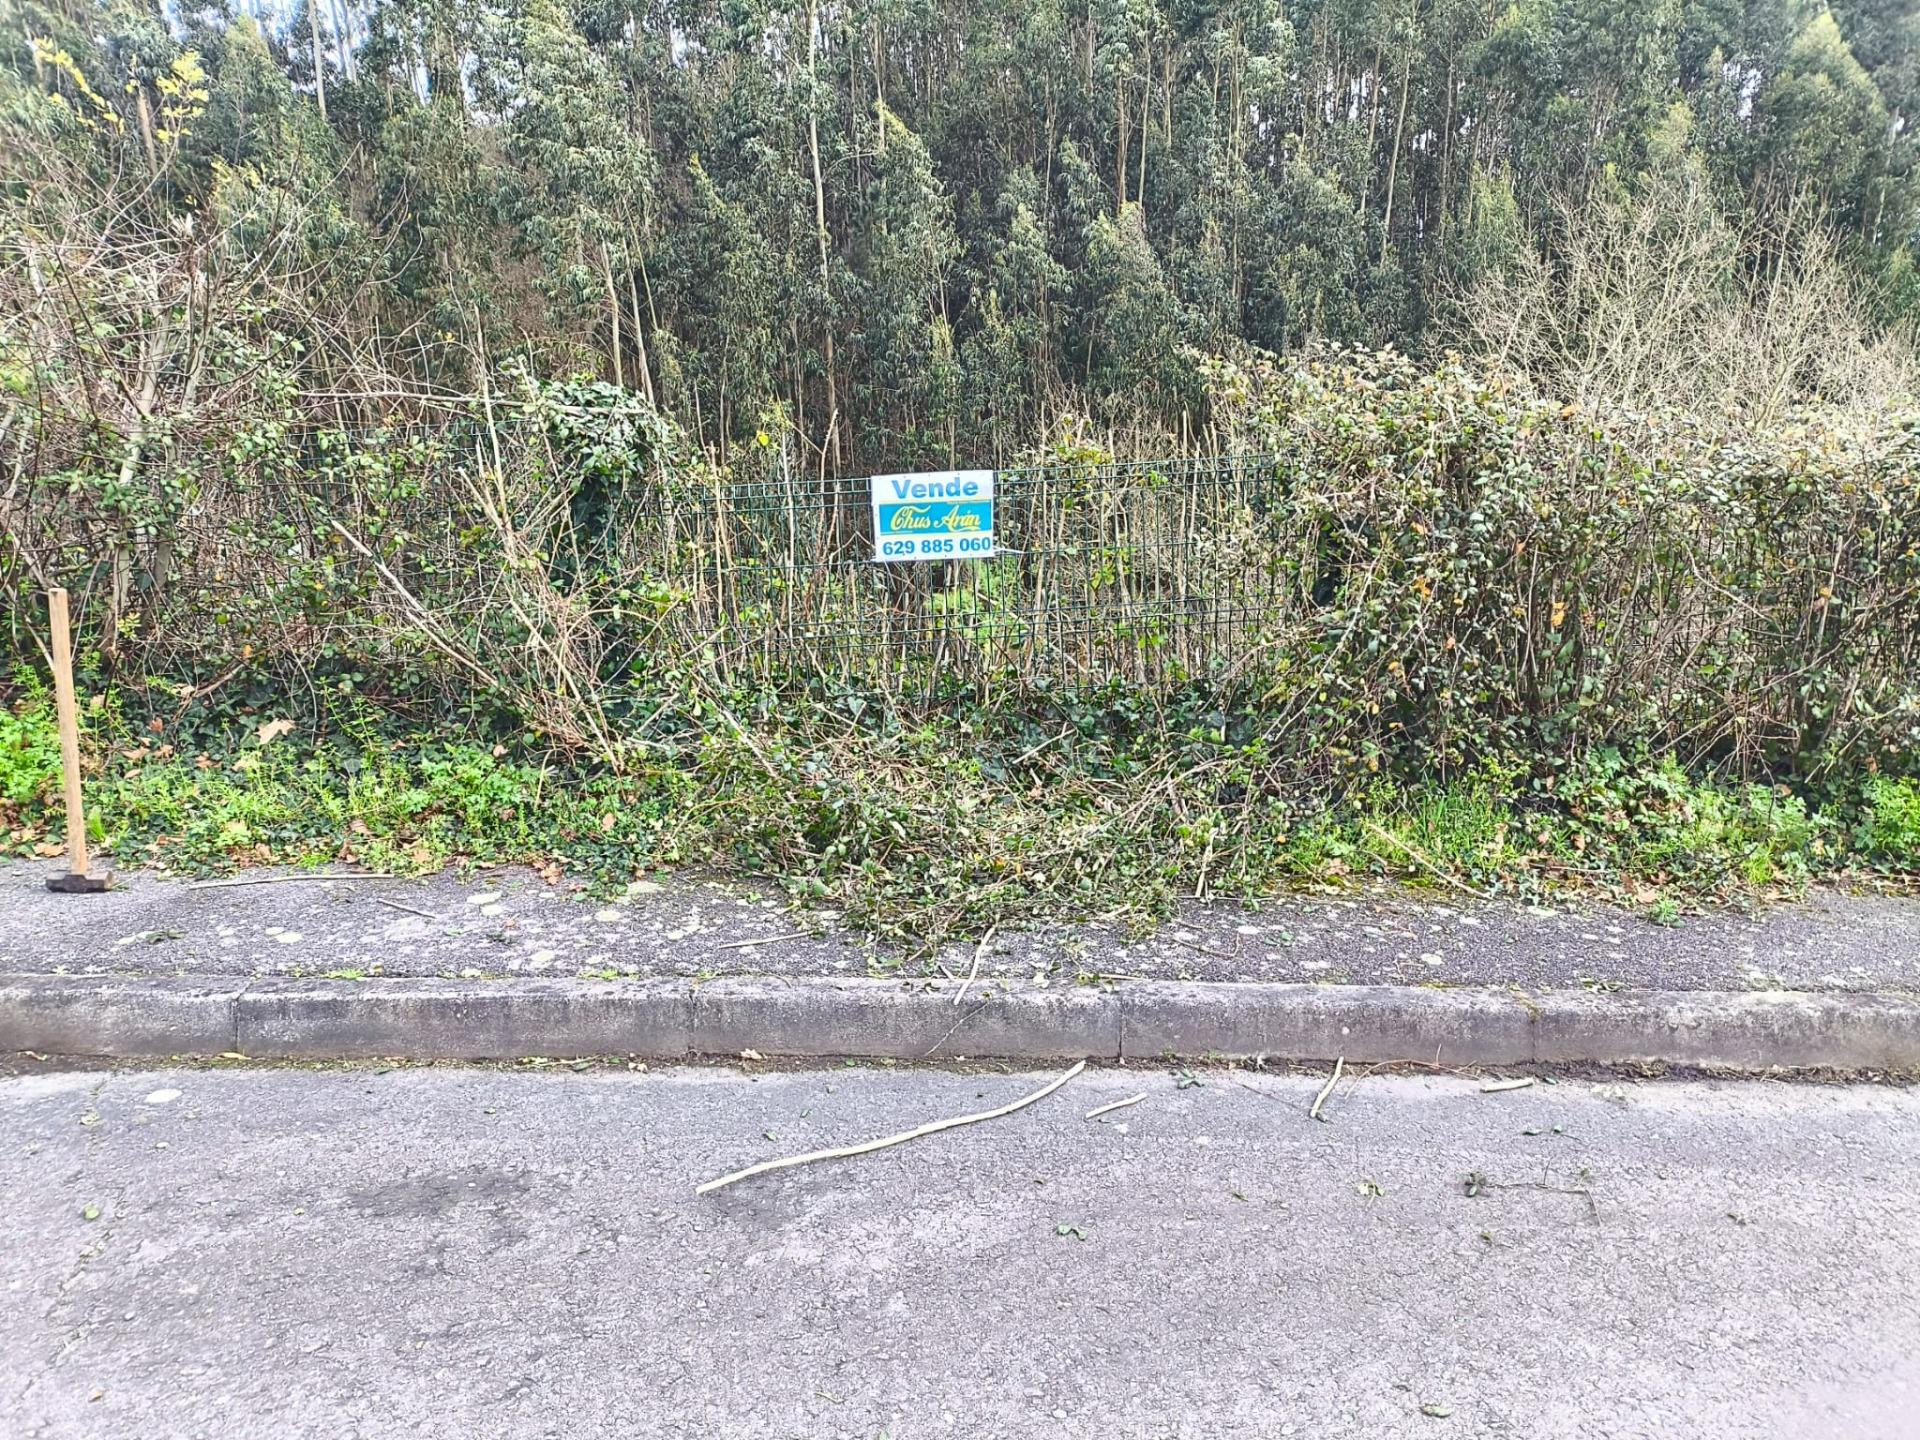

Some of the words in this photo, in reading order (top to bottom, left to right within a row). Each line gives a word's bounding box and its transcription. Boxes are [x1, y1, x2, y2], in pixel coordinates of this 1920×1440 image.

[891, 477, 979, 499] Vende
[890, 505, 931, 531] Chus
[883, 540, 915, 555] 629
[921, 539, 954, 553] 885
[959, 537, 991, 551] 060
